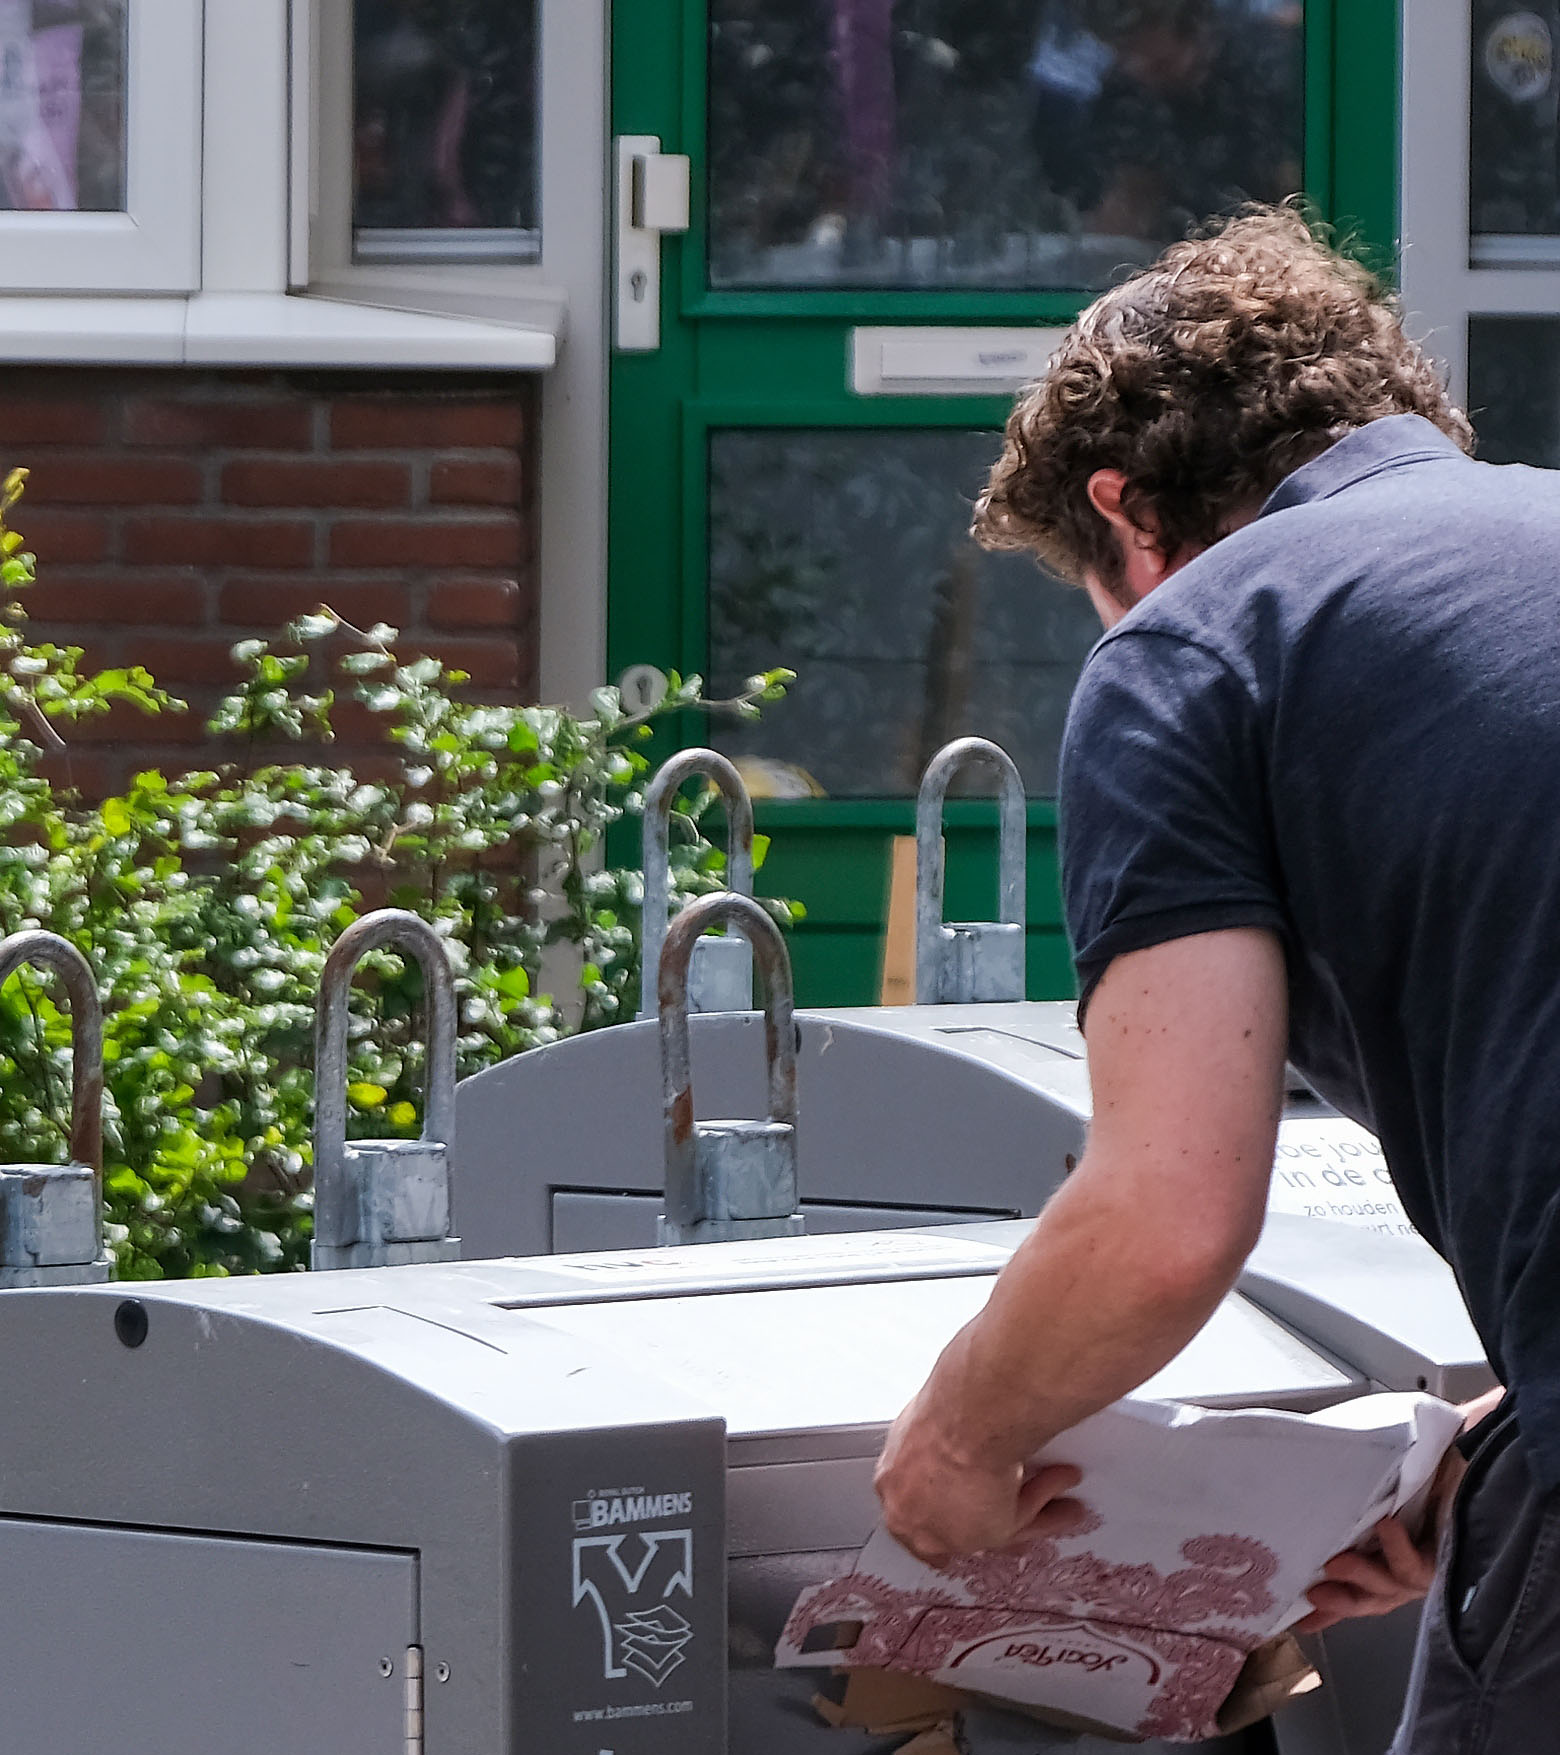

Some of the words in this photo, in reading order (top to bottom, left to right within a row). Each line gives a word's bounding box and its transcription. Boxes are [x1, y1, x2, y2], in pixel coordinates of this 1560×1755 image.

[1320, 1137, 1385, 1163] jou
[1322, 1162, 1365, 1187] de
[1330, 1200, 1399, 1217] houden
[591, 1492, 692, 1528] BAMMENS
